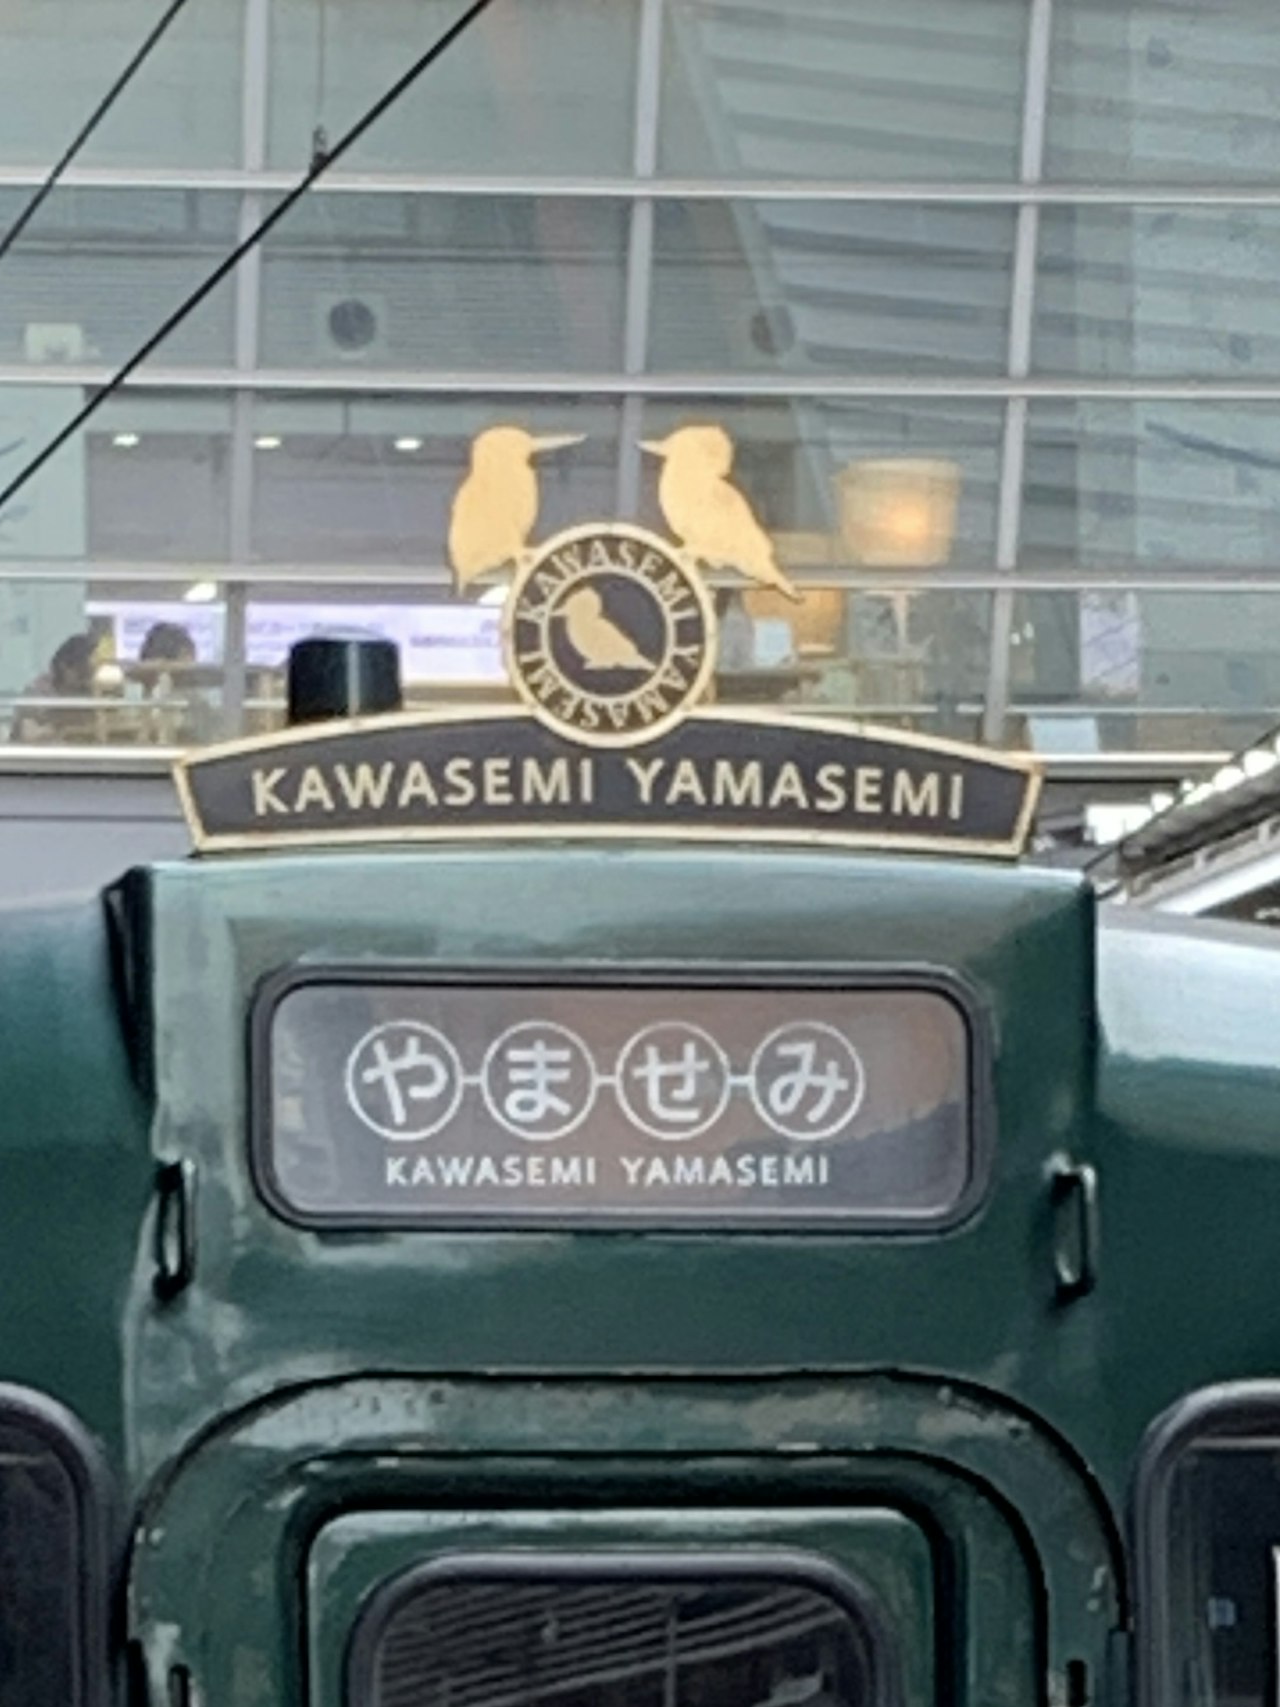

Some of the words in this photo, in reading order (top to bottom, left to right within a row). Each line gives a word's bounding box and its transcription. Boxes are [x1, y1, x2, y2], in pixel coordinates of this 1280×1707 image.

[516, 538, 700, 624] KAWASEMI
[517, 643, 702, 730] YAMASEMI
[251, 757, 593, 816] KAWASEMI
[627, 757, 964, 820] YAMASEMI
[362, 1036, 850, 1126] やませみ
[385, 1156, 596, 1186] KAWASEMI
[620, 1156, 830, 1185] YAMASEMI
